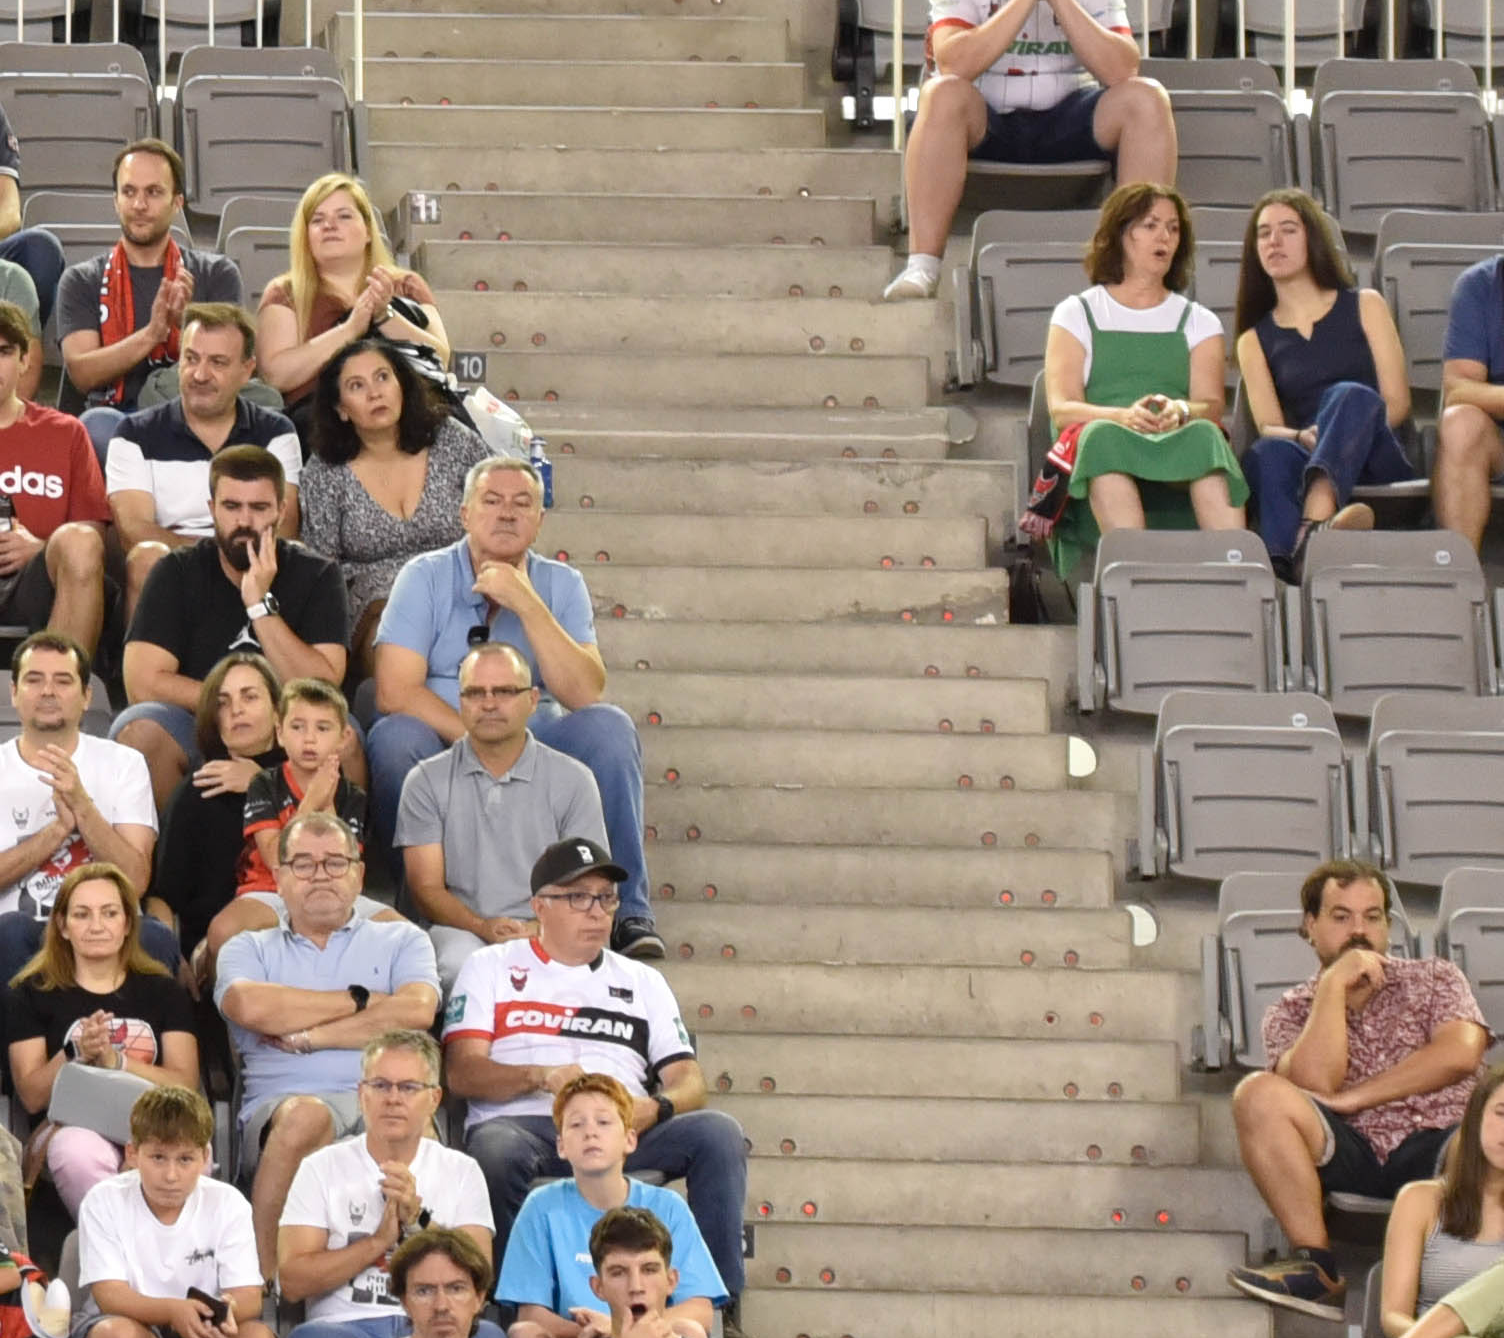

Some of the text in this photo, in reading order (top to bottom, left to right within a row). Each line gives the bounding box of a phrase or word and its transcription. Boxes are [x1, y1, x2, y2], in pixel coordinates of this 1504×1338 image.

[411, 194, 438, 222] 11
[461, 356, 483, 380] 10
[504, 1006, 635, 1040] COVIRAN
